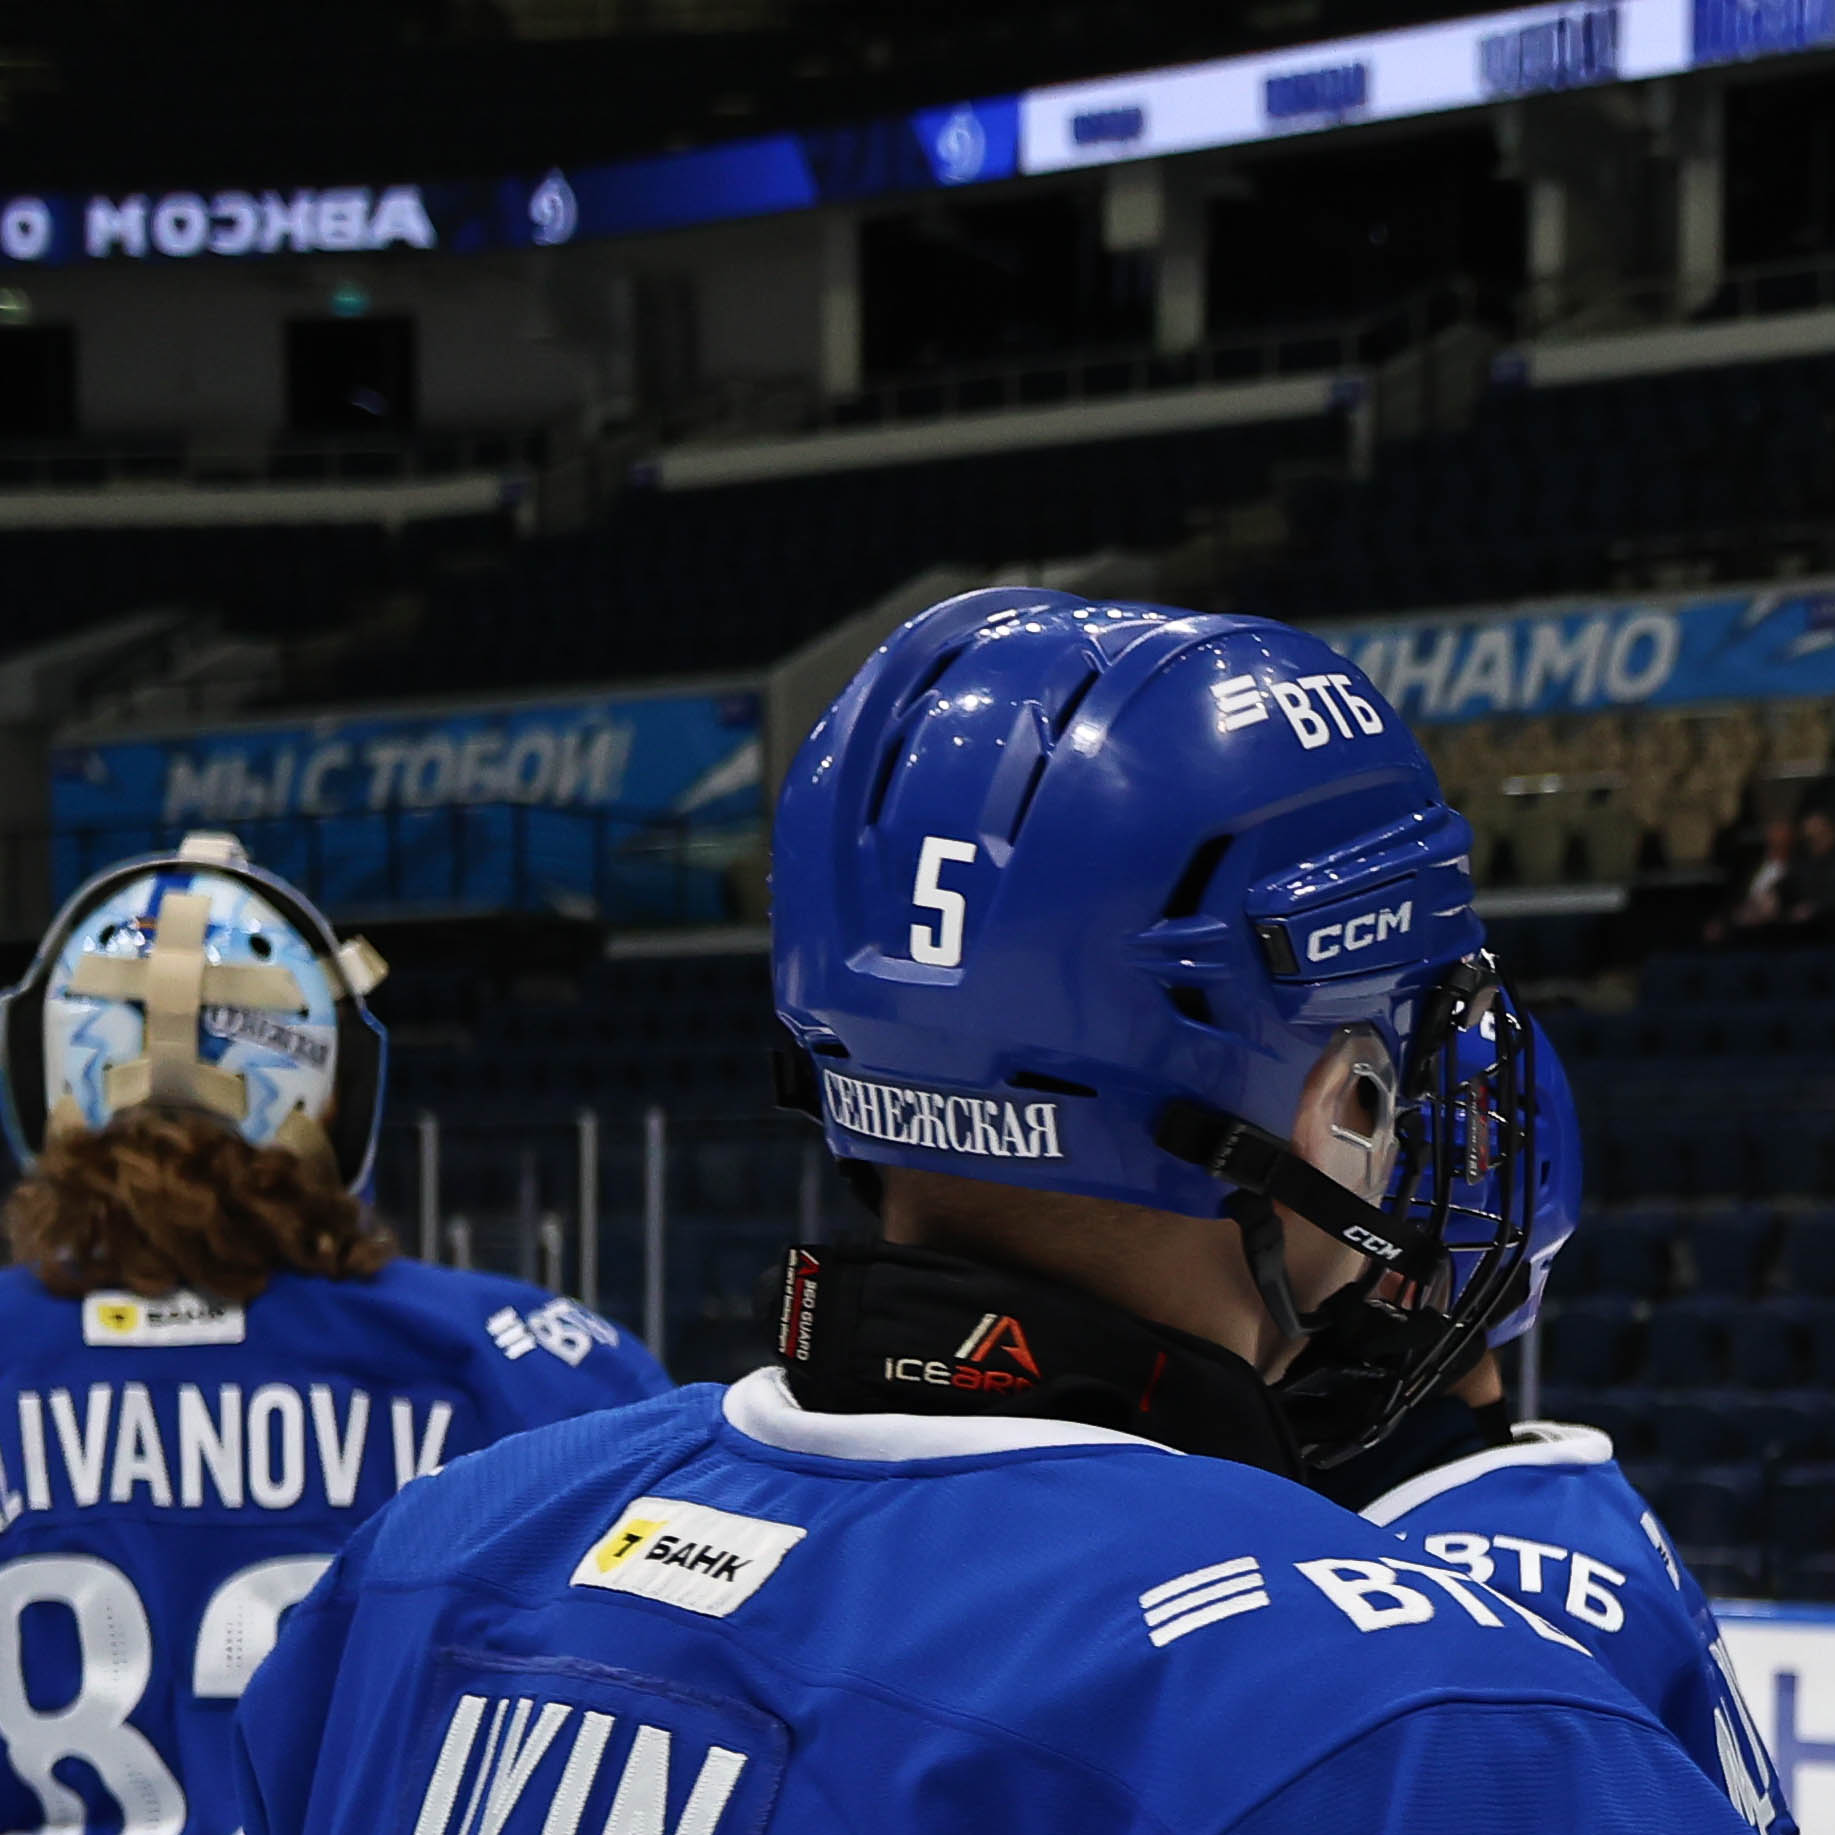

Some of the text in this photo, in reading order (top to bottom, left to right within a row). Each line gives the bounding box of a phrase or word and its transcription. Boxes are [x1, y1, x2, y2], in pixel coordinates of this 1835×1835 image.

[1270, 673, 1384, 750] ВТБ
[163, 746, 297, 824] МЫ
[303, 737, 353, 817] С
[909, 836, 977, 968] 5
[1306, 901, 1414, 963] CCM
[823, 1068, 1064, 1159] СЕНЕЖСКАЯ
[1341, 1224, 1404, 1261] CCM
[645, 1536, 754, 1583] БАНК
[1424, 1532, 1628, 1633] ВТБ
